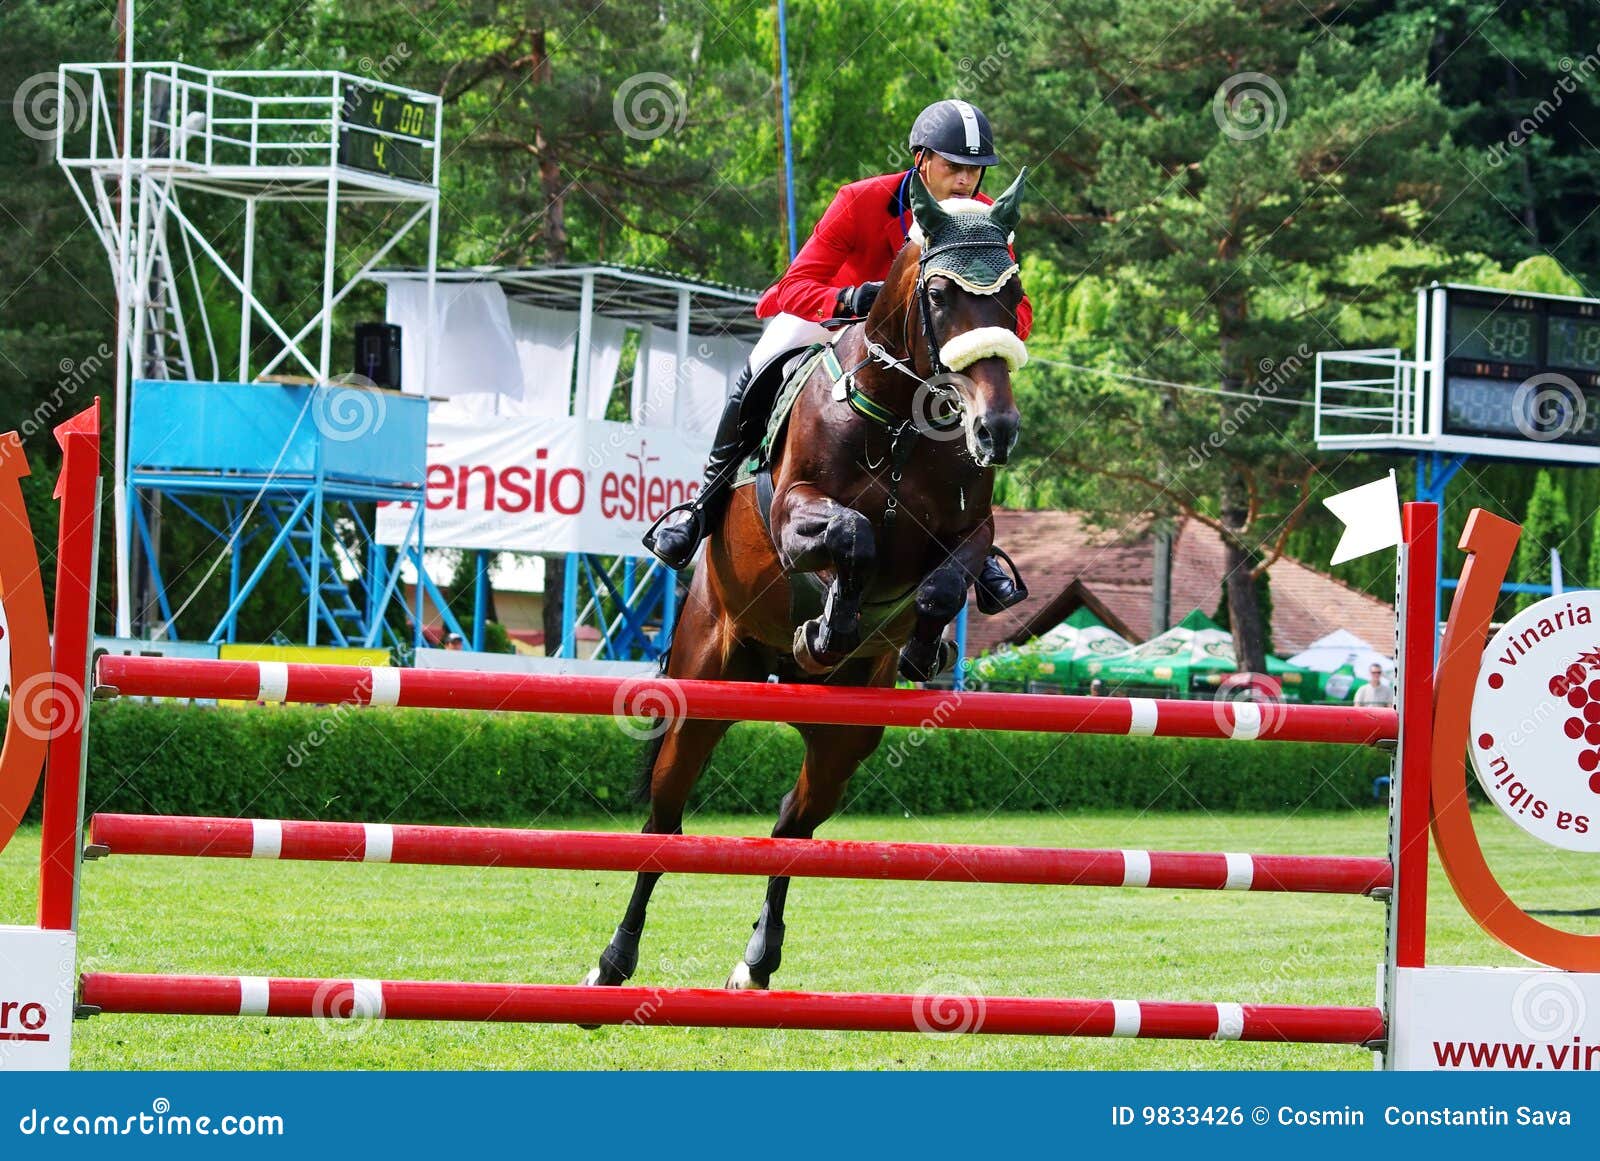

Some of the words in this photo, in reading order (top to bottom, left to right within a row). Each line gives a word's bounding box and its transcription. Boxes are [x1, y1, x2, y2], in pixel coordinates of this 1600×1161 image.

[372, 100, 384, 125] 4
[1499, 603, 1591, 667] vinaria
[1489, 756, 1549, 820] sibiu
[1556, 811, 1590, 834] sa
